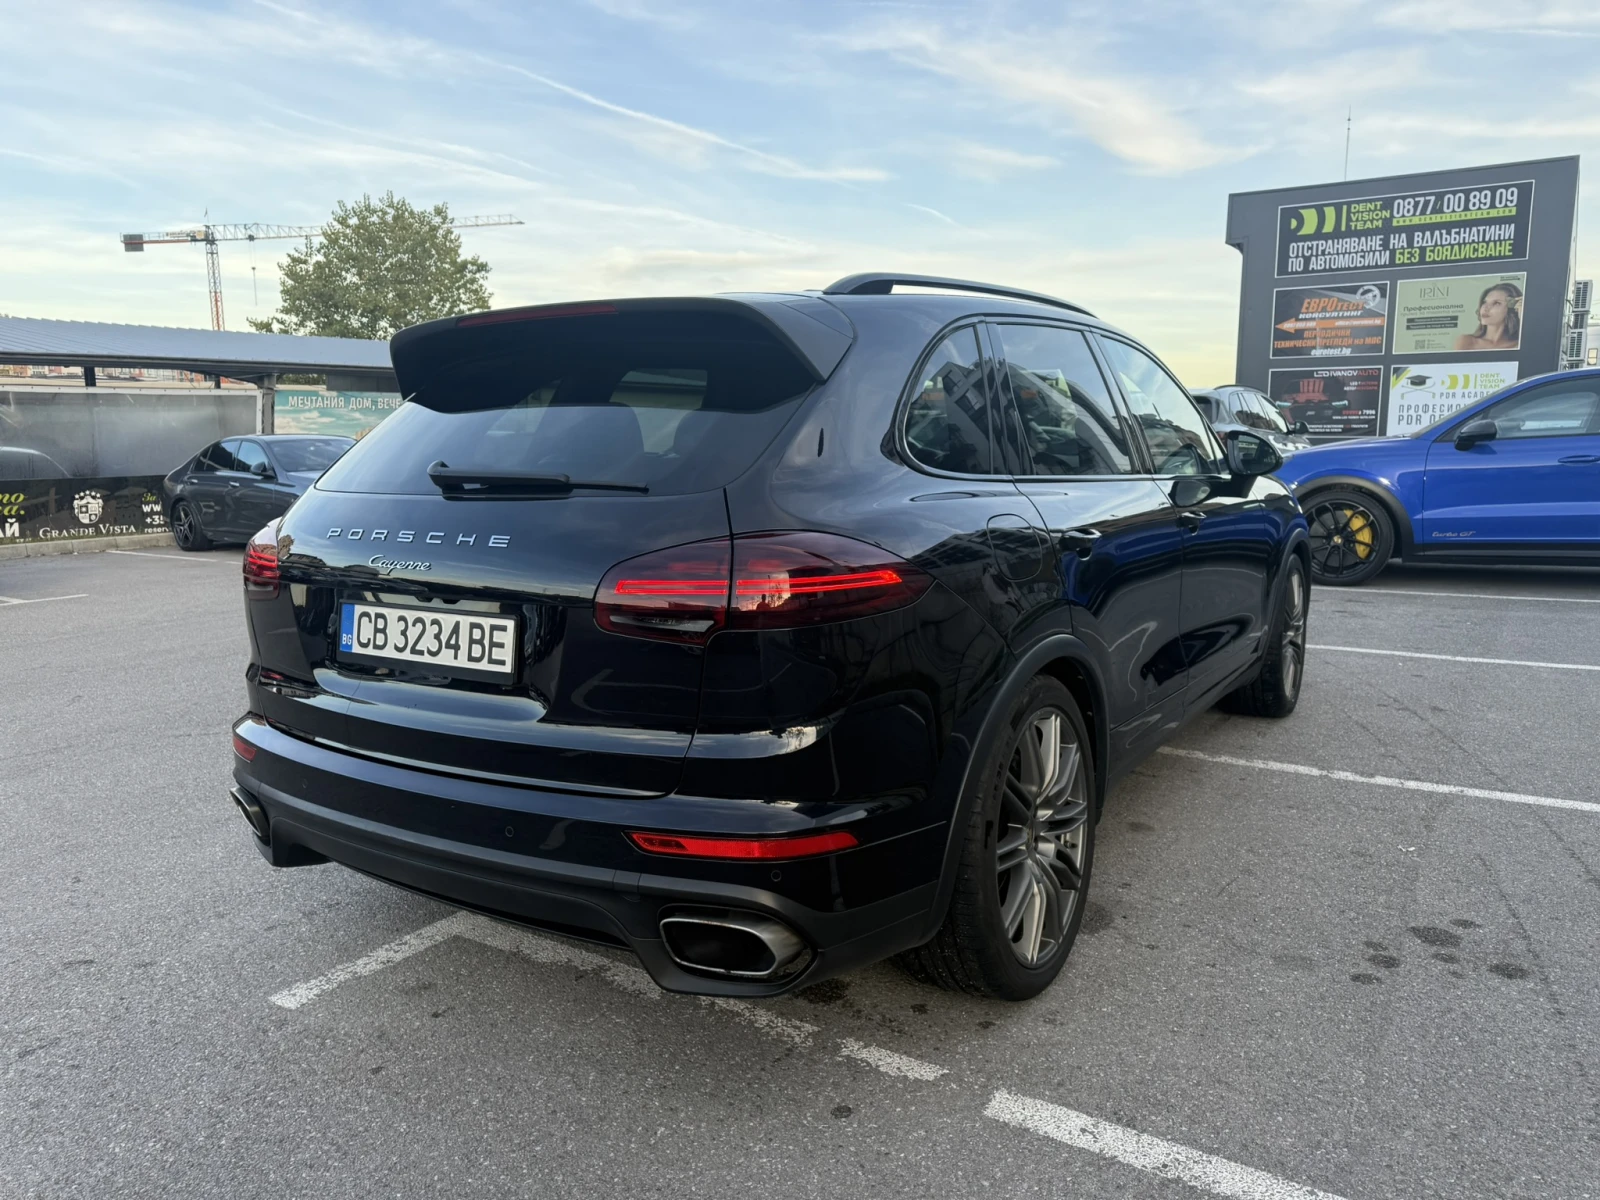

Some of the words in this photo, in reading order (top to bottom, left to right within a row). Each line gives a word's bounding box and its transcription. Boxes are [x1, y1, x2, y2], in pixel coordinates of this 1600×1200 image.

[1351, 202, 1382, 213] DENT
[1393, 196, 1436, 218] 0877
[1443, 193, 1465, 213] 00
[1469, 190, 1491, 210] 89
[1495, 187, 1518, 208] 09
[1350, 210, 1390, 222] VISION
[1350, 220, 1383, 230] TEAM
[1289, 235, 1384, 258] ОТСТРАНЯВАНЕ
[1390, 233, 1406, 249] НА
[1413, 224, 1515, 248] ВДЛЪБНАТИНИ
[1288, 257, 1303, 272] ПО
[1309, 250, 1390, 270] АВТОМОБИЛИ
[1395, 249, 1419, 264] БЕЗ
[1425, 241, 1513, 262] БОЯДИСВАНЕ
[1403, 304, 1464, 312] Професионална
[288, 396, 345, 408] МЕЧТАНИЯ
[349, 397, 375, 411] ДОМ,
[1399, 403, 1467, 414] ПРОФЕСИО
[1398, 414, 1422, 425] PDR
[39, 527, 96, 539] GRANDE
[99, 523, 136, 534] VISTA
[326, 527, 512, 549] PORSCHE
[368, 554, 432, 575] Cayenne
[342, 634, 352, 646] BG
[357, 610, 389, 652] CB
[394, 614, 461, 660] 3234
[467, 622, 508, 666] BE
